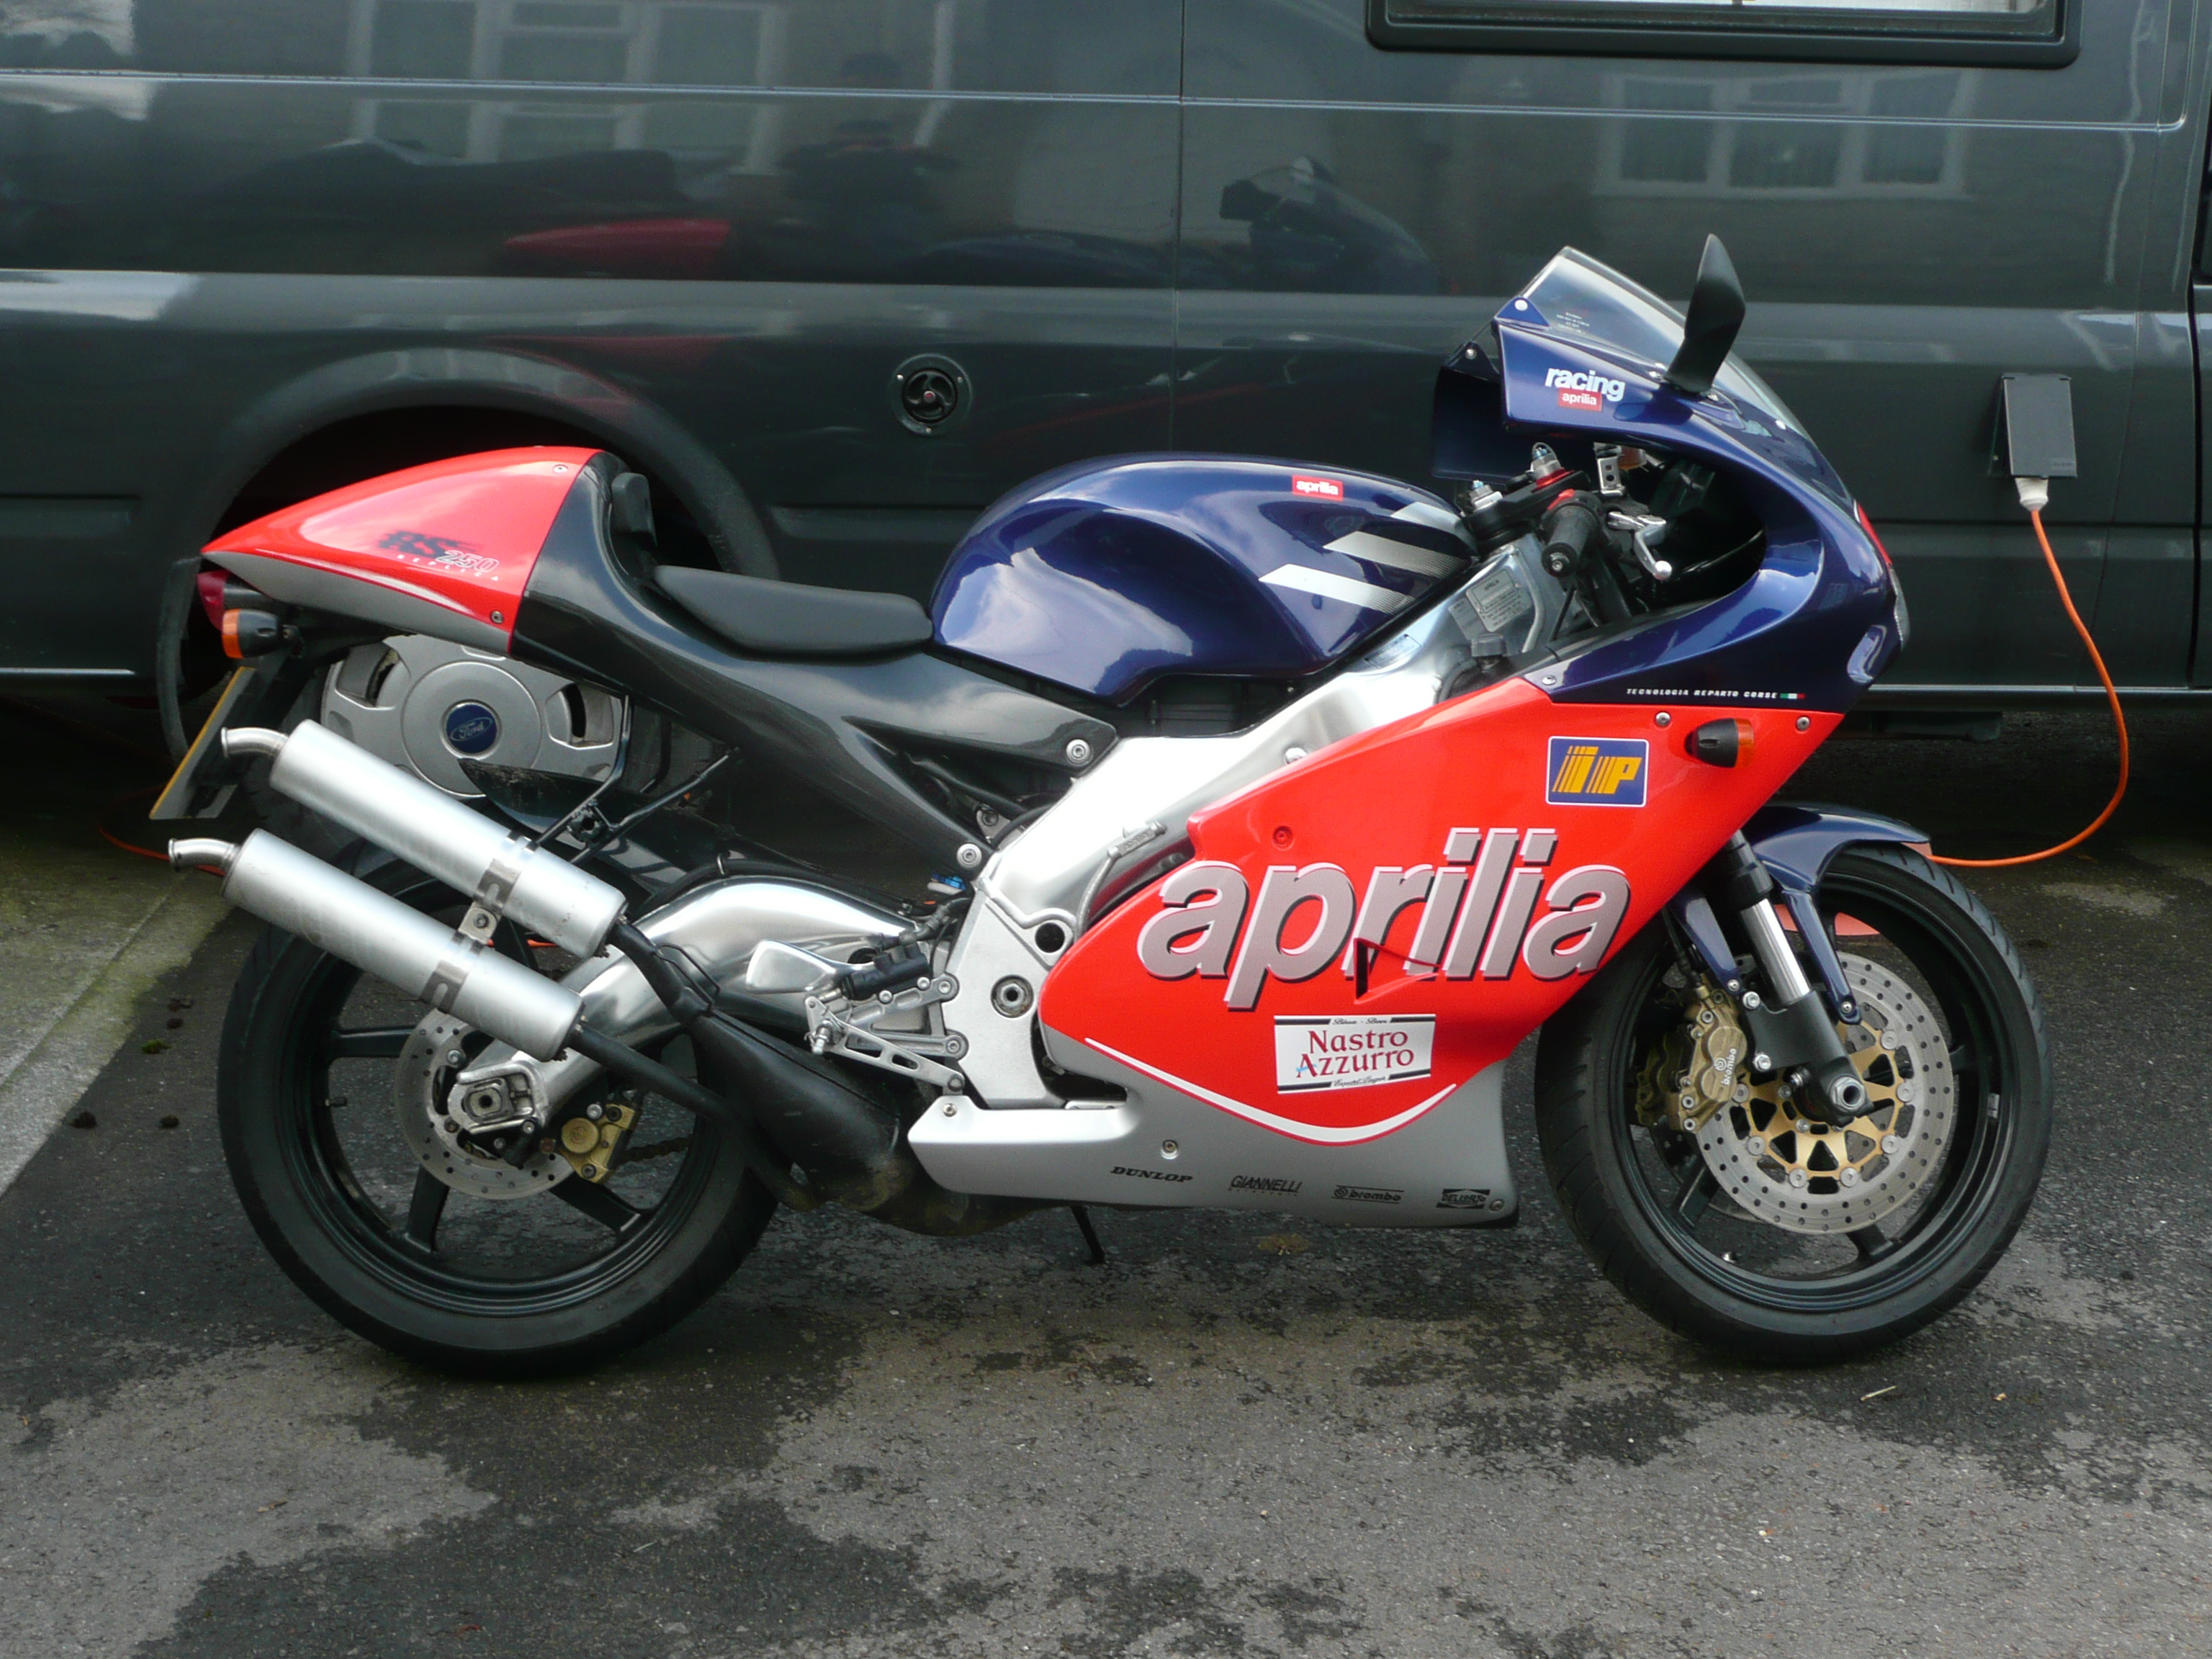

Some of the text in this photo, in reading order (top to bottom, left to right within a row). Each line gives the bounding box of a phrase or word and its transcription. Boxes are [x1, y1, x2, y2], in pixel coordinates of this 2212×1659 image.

[1545, 368, 1626, 402] racing
[1562, 392, 1597, 405] aprilia
[1296, 481, 1339, 495] aprilia
[436, 550, 499, 572] 250
[1137, 828, 1631, 1011] aprilia
[1308, 1029, 1408, 1053] Nastro
[1296, 1048, 1414, 1078] Azzurro
[1721, 1048, 1737, 1086] brembo
[1110, 1166, 1193, 1182] DUNLOP
[1231, 1175, 1303, 1193] GIANNELLI
[1349, 1189, 1401, 1201] brembo
